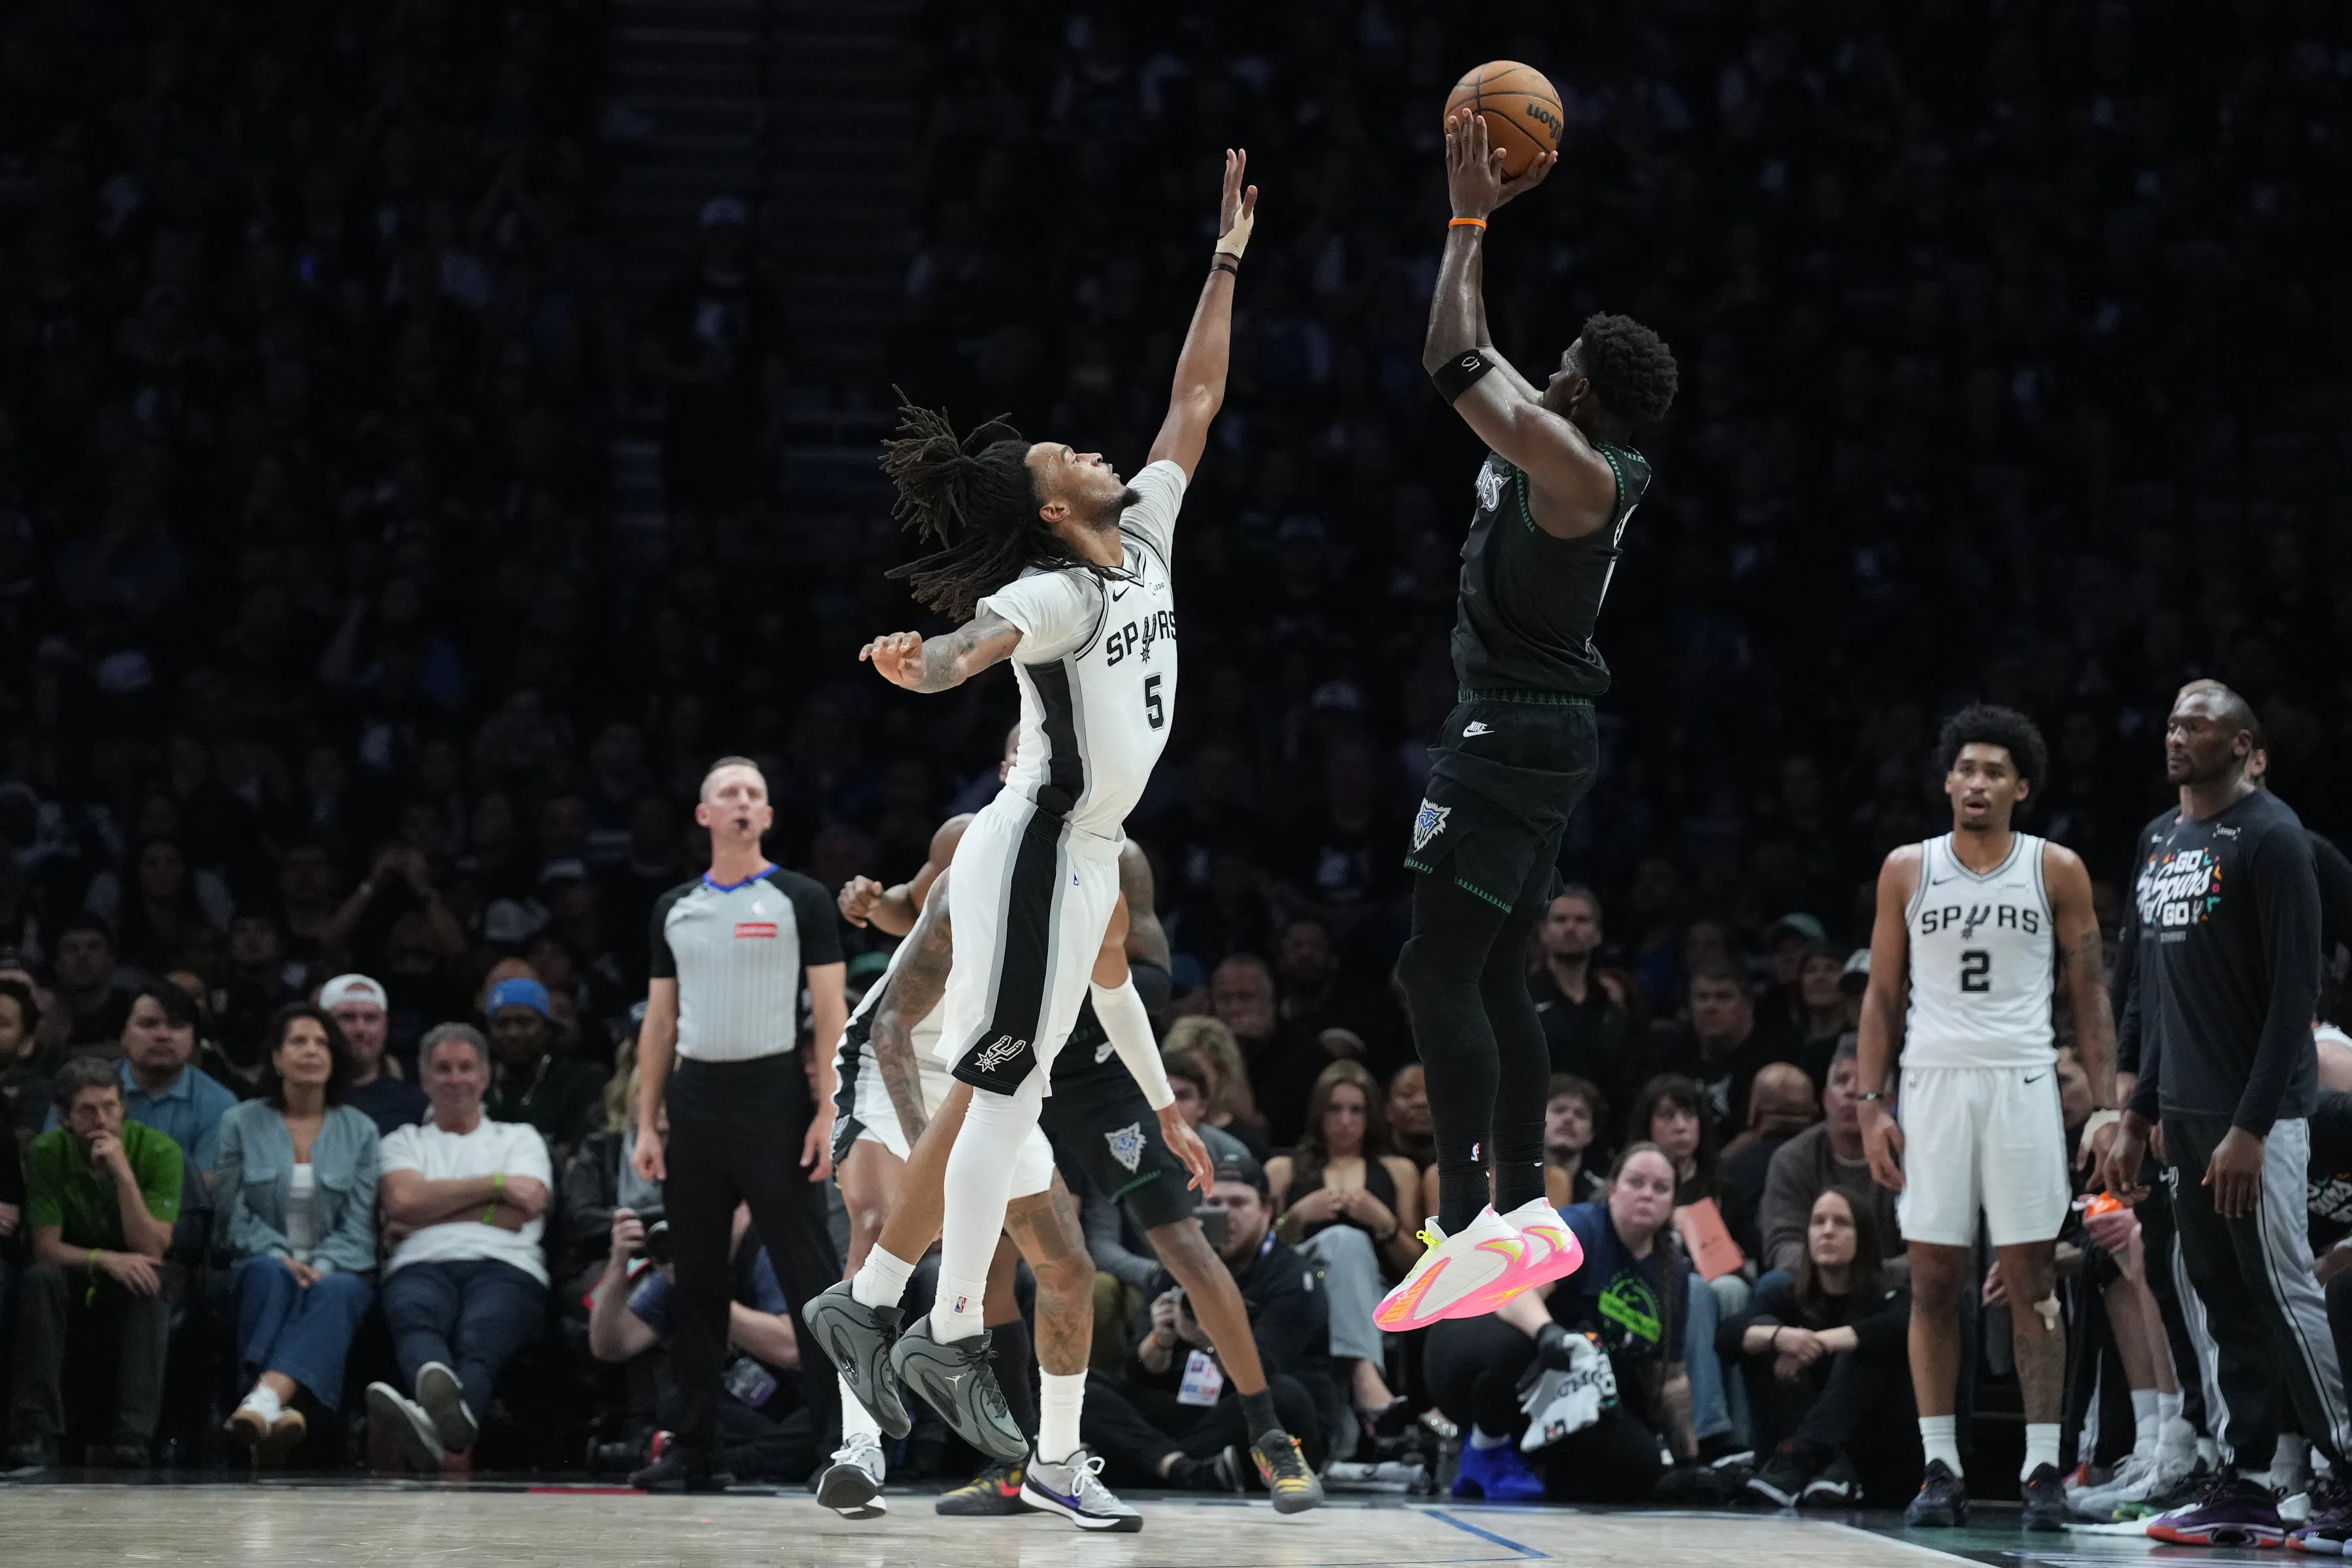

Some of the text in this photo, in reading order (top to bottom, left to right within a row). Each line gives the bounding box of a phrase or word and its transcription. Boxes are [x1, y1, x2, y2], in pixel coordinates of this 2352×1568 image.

[1107, 610, 1177, 666] SPURS
[1143, 672, 1166, 732] 5
[1467, 721, 1488, 732] NIKE
[2174, 849, 2203, 874] GO
[2152, 861, 2213, 918] Spurs
[1921, 903, 2039, 940] SPURS
[2162, 901, 2189, 926] GO
[1960, 949, 1991, 992] 2
